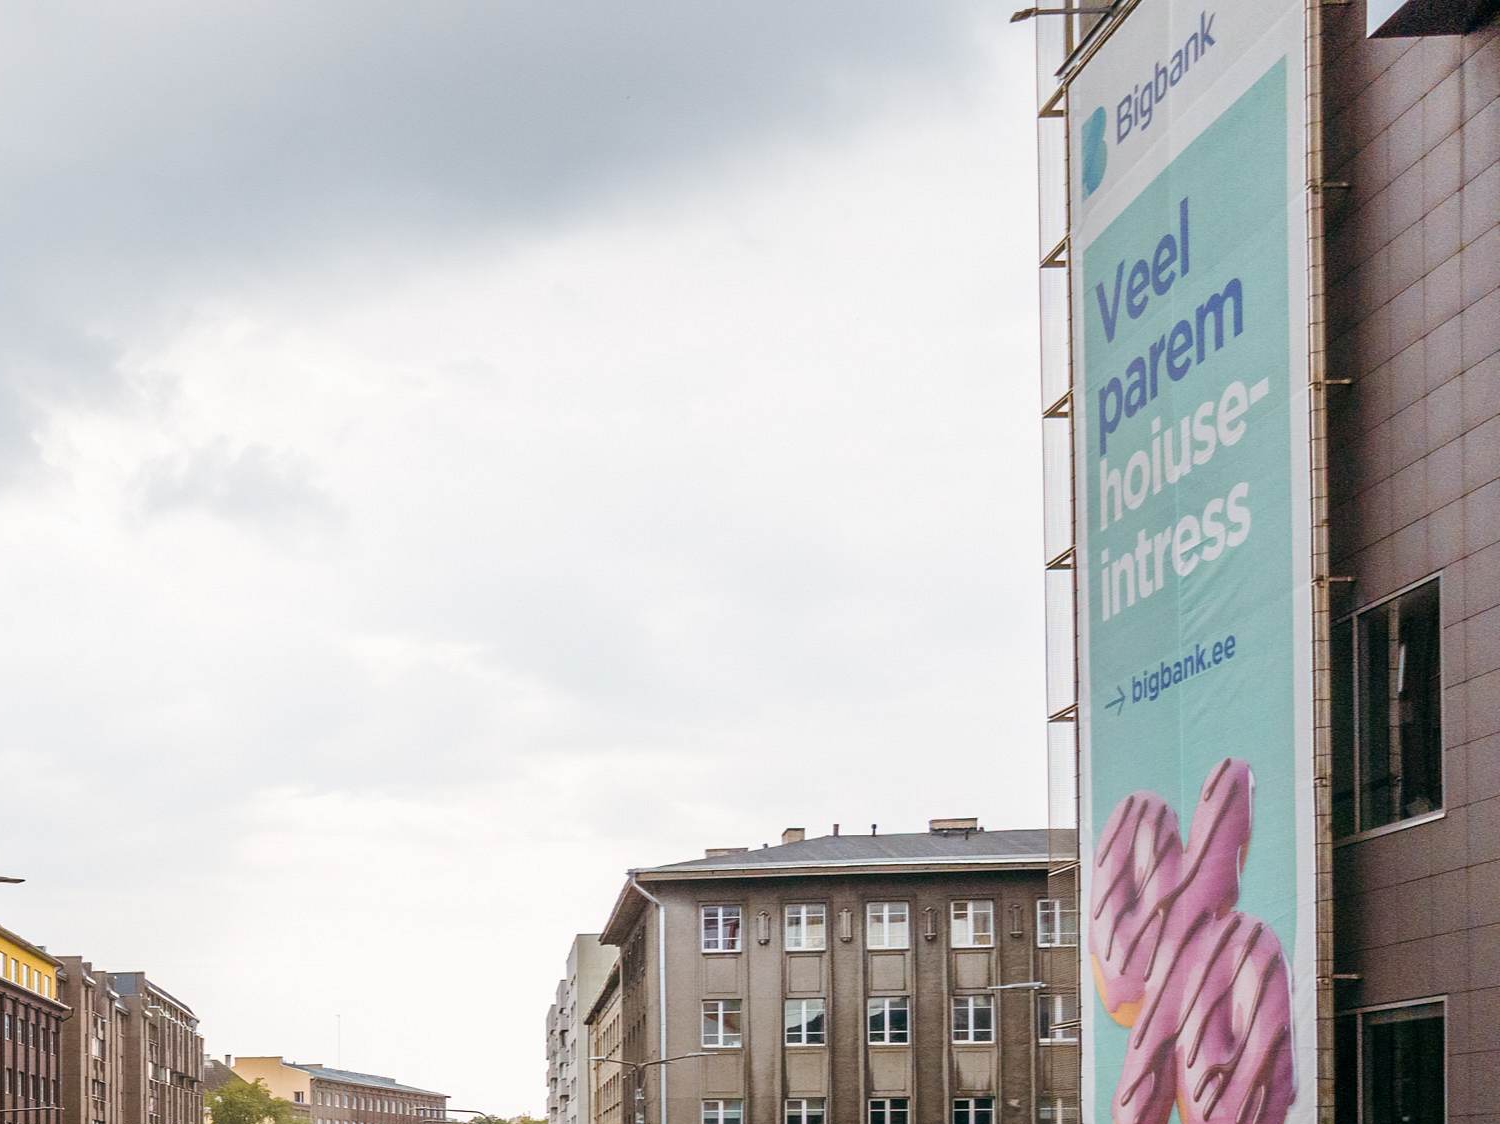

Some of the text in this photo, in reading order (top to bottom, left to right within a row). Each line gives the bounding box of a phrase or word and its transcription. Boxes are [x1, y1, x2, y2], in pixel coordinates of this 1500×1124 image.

[1116, 10, 1216, 145] Bigbank
[1095, 196, 1189, 343] Veel
[1097, 278, 1243, 458] parem
[1099, 377, 1269, 532] hoiuse-
[1100, 481, 1252, 622] intress
[1131, 634, 1237, 705] bigbank.ee
